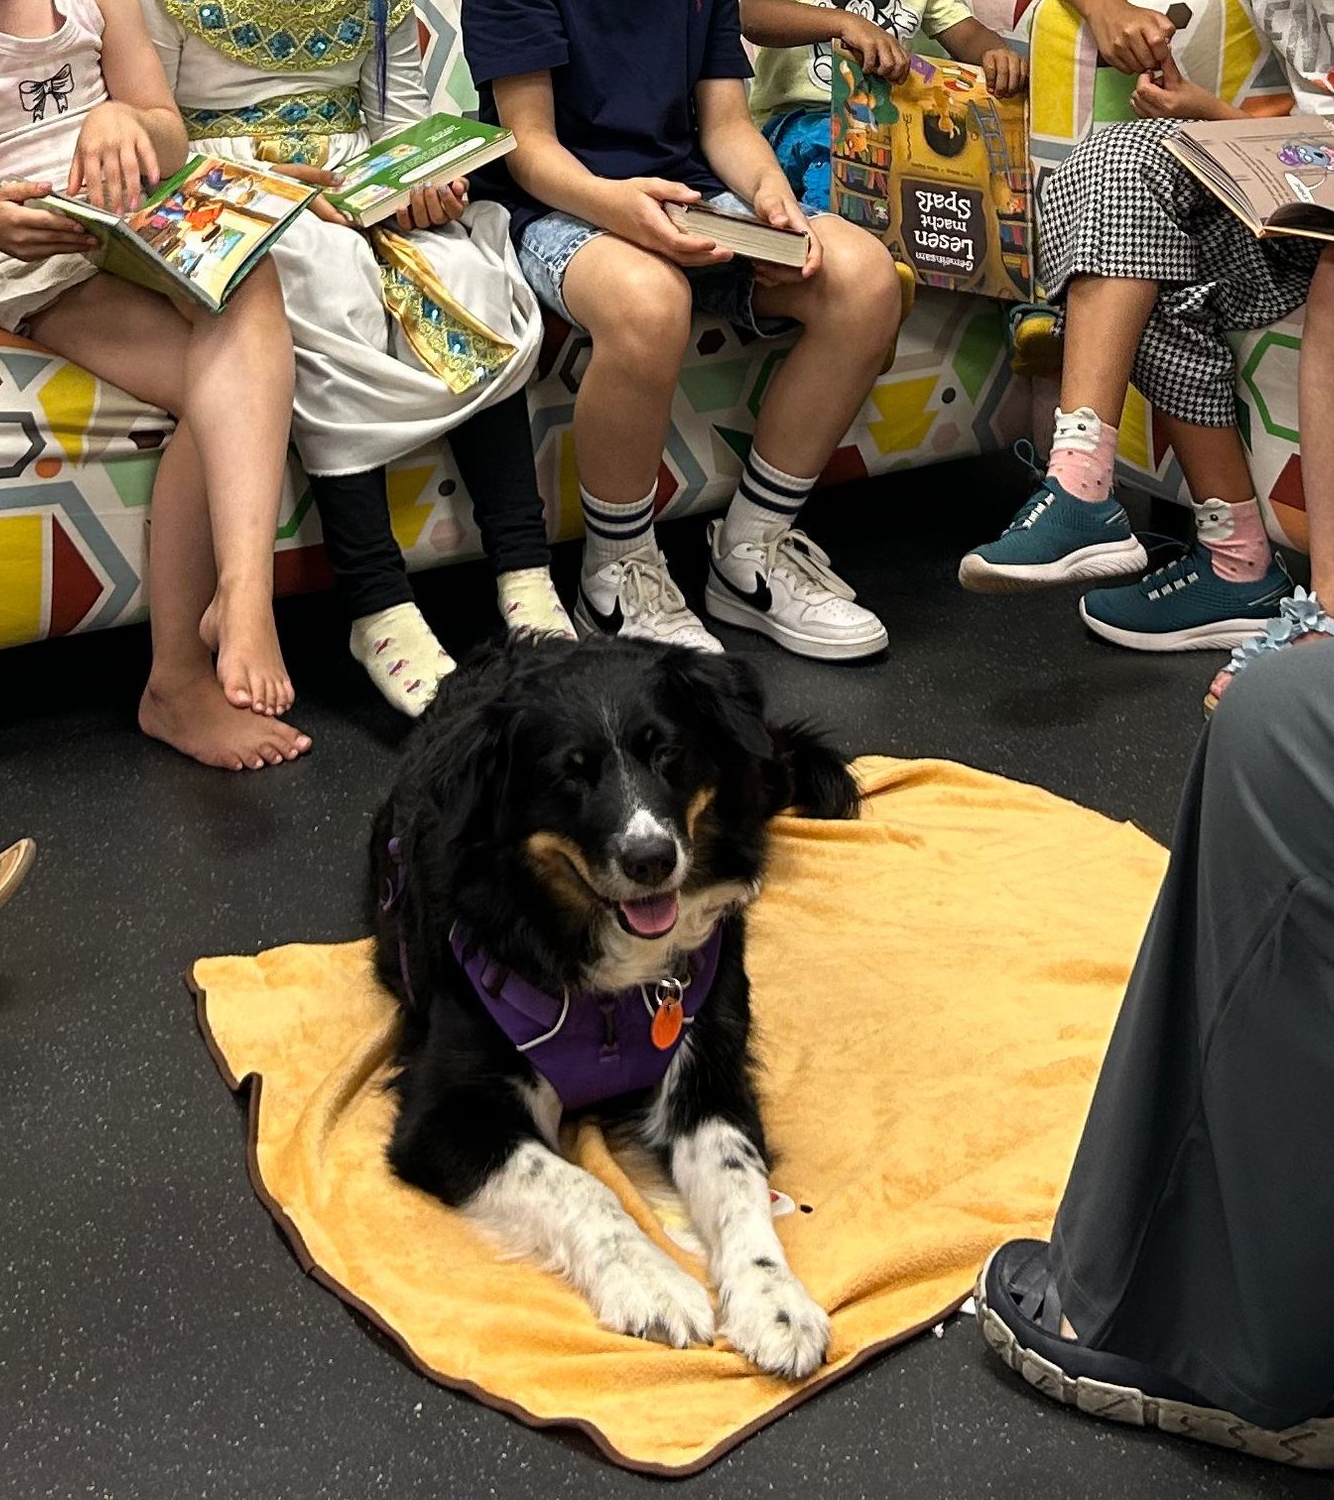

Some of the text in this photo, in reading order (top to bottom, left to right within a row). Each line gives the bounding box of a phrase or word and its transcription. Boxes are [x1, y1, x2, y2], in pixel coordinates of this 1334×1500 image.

[915, 190, 971, 219] Spaß
[920, 214, 967, 232] macht
[914, 230, 974, 260] Lesen
[915, 251, 974, 272] Gemeinsam
